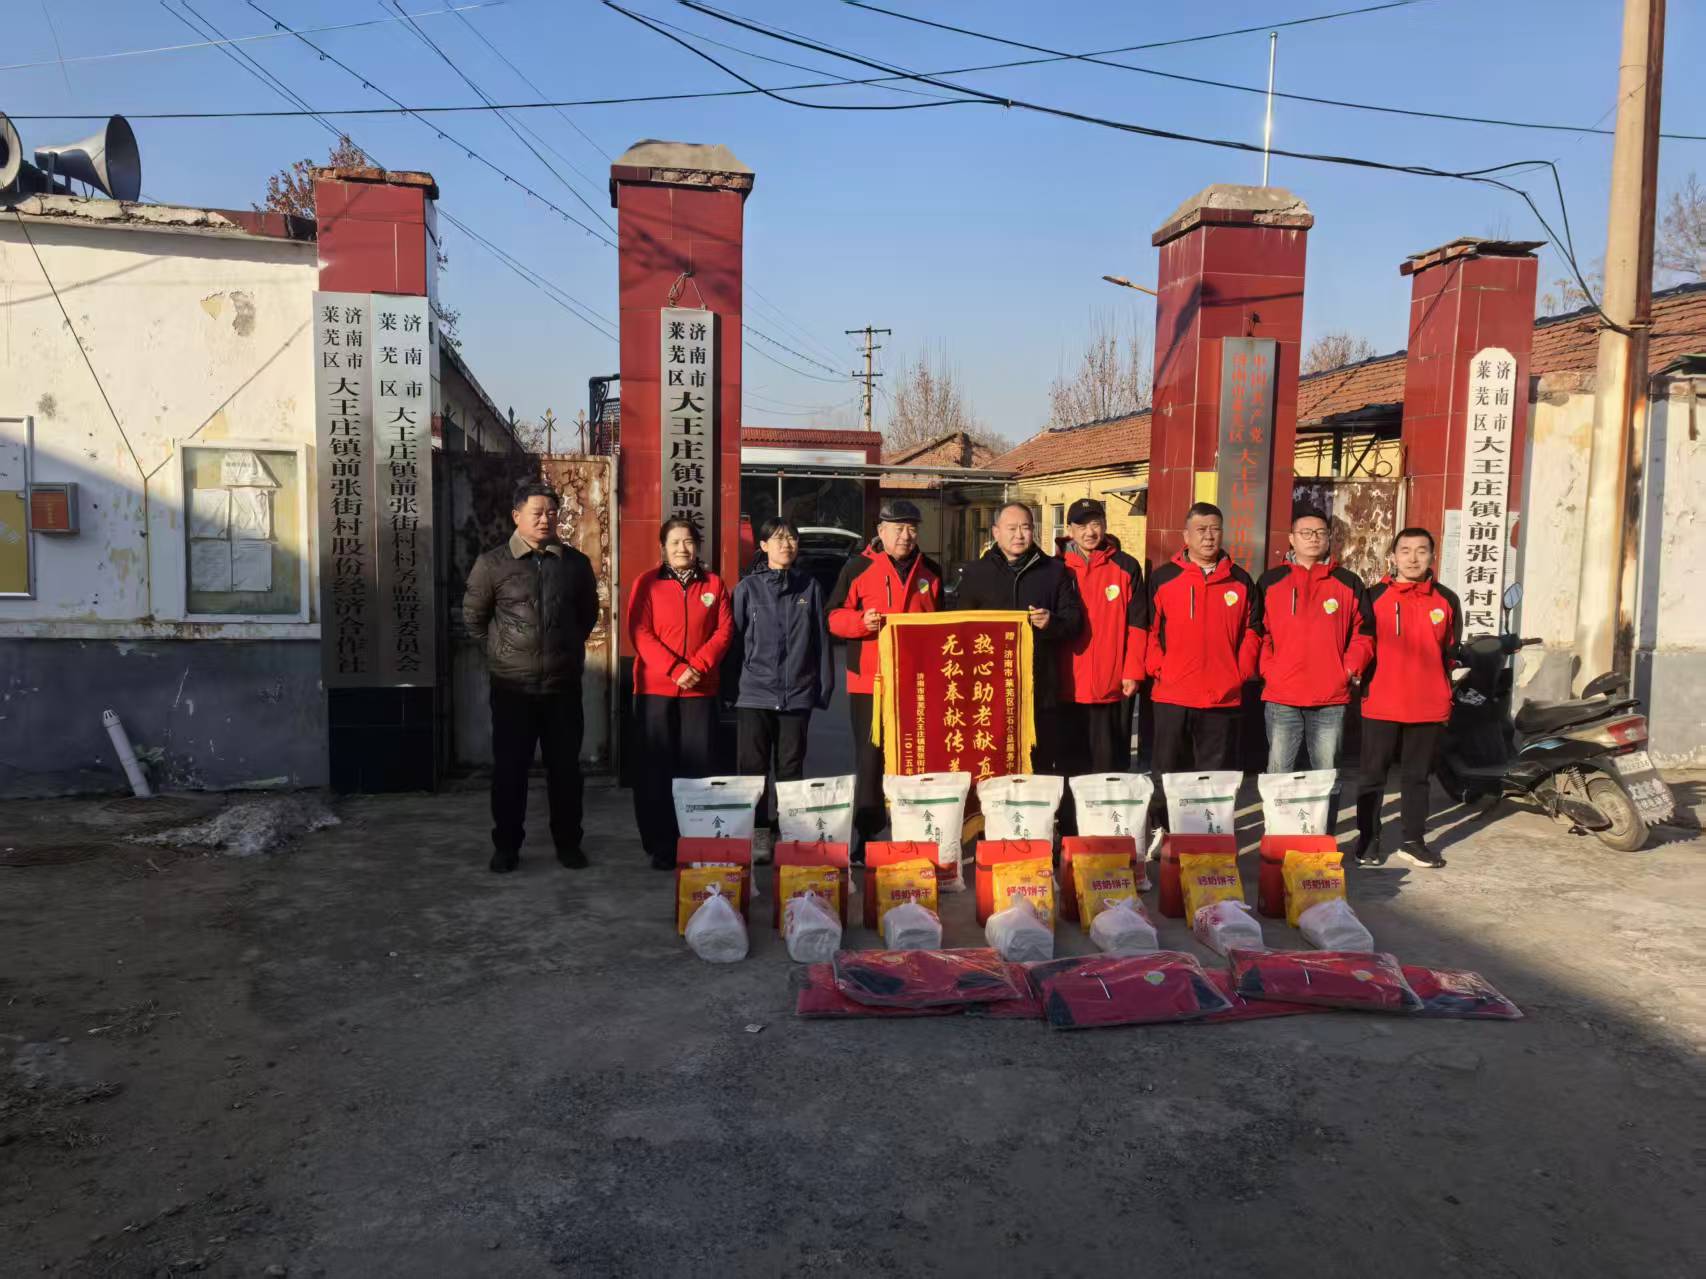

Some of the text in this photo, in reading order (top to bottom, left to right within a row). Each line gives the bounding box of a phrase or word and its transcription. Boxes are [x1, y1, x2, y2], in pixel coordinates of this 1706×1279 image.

[321, 306, 341, 369] 莱芜区
[346, 307, 363, 370] 济南市
[377, 312, 398, 399] 莱芜区
[404, 313, 425, 399] 济南市
[668, 321, 686, 387] 莱芜区
[689, 322, 707, 388] 济南市
[1473, 361, 1492, 431] 莱芜区
[1493, 361, 1512, 432] 济南市
[1463, 435, 1506, 641] 大王庄镇前张街村民
[972, 633, 997, 781] 热心助老献真
